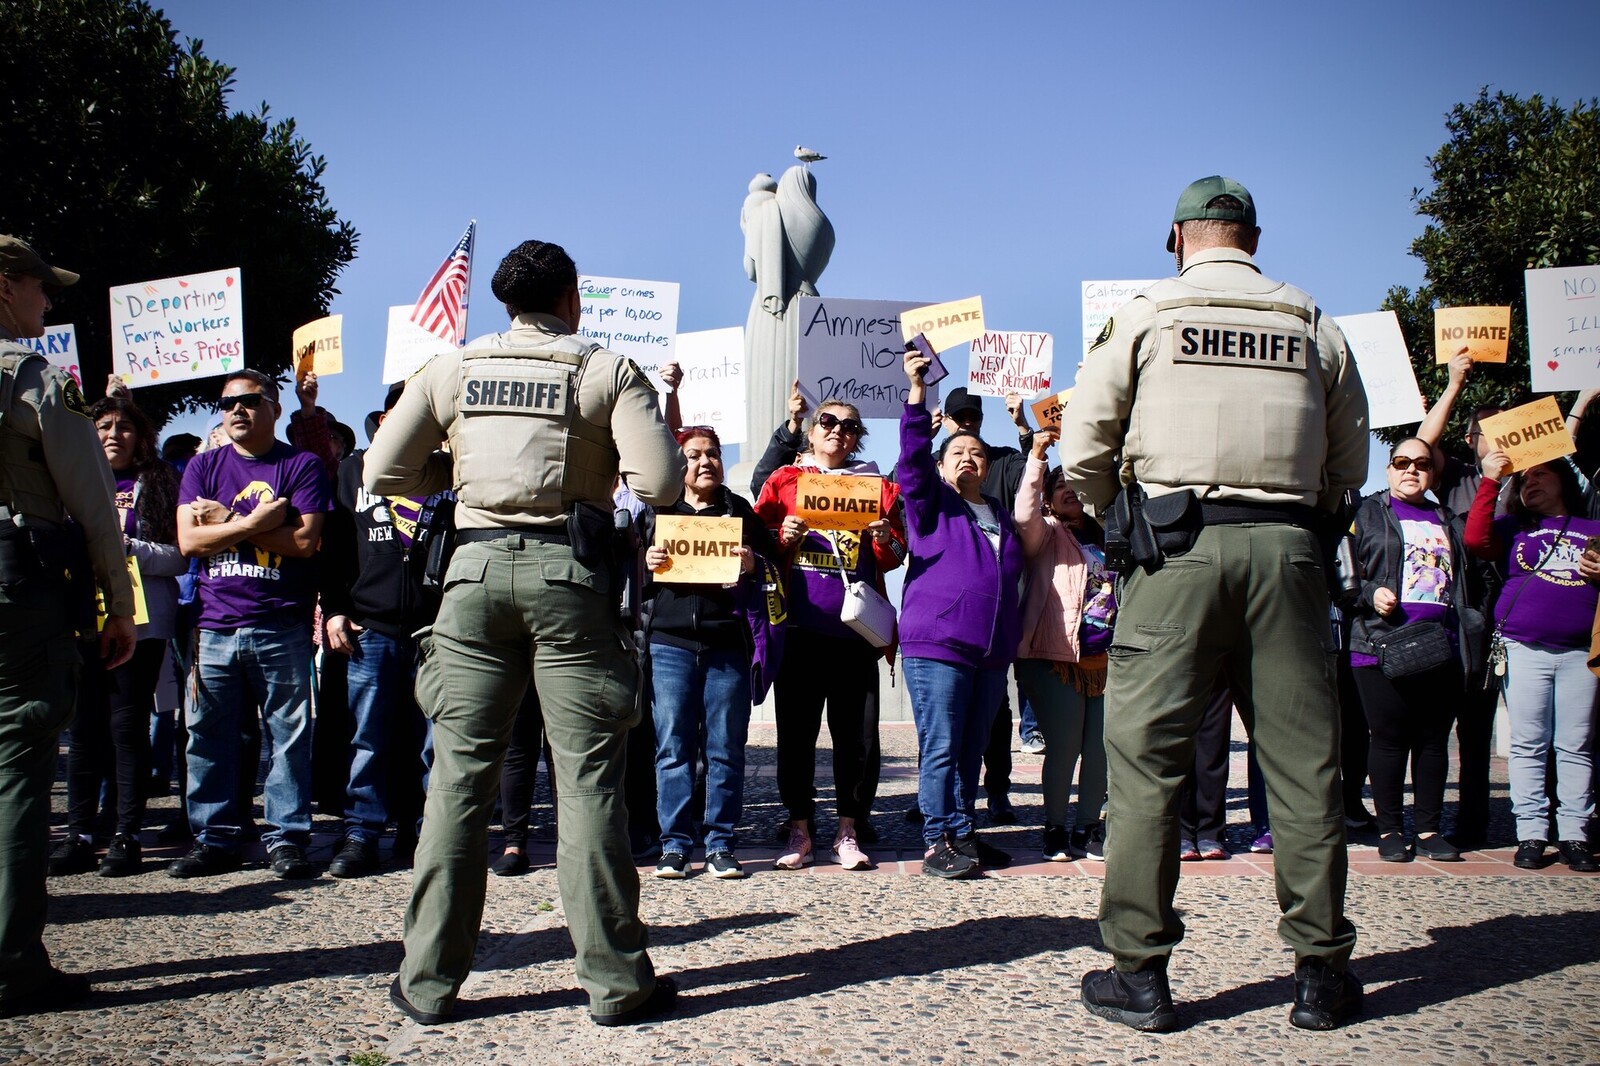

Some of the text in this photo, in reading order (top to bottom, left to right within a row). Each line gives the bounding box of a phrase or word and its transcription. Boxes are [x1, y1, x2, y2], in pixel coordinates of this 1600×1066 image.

[620, 287, 655, 299] crimes
[1564, 277, 1596, 296] NO
[126, 289, 226, 318] Deporting
[580, 305, 662, 322] ed per 10,000
[122, 316, 230, 346] Farm Workers
[804, 302, 902, 337] Amnest
[909, 310, 981, 336] NO HATE
[577, 326, 669, 350] tuary counties
[971, 332, 1048, 358] AMNESTY
[1181, 327, 1301, 363] SHERIFF
[1441, 326, 1507, 341] NO HATE
[126, 337, 240, 375] Raises Prices
[296, 335, 340, 363] NO HATE
[970, 371, 997, 386] MASS
[465, 380, 562, 409] SHERIFF
[1494, 416, 1565, 450] NO HATE
[803, 495, 878, 513] NO HATE
[368, 526, 393, 541] NEW
[208, 553, 239, 567] SEIU
[663, 539, 740, 557] NO HATE
[208, 564, 281, 580] for HARRIS
[1516, 553, 1534, 571] CLAS
[1535, 571, 1586, 586] RABAJADORA
